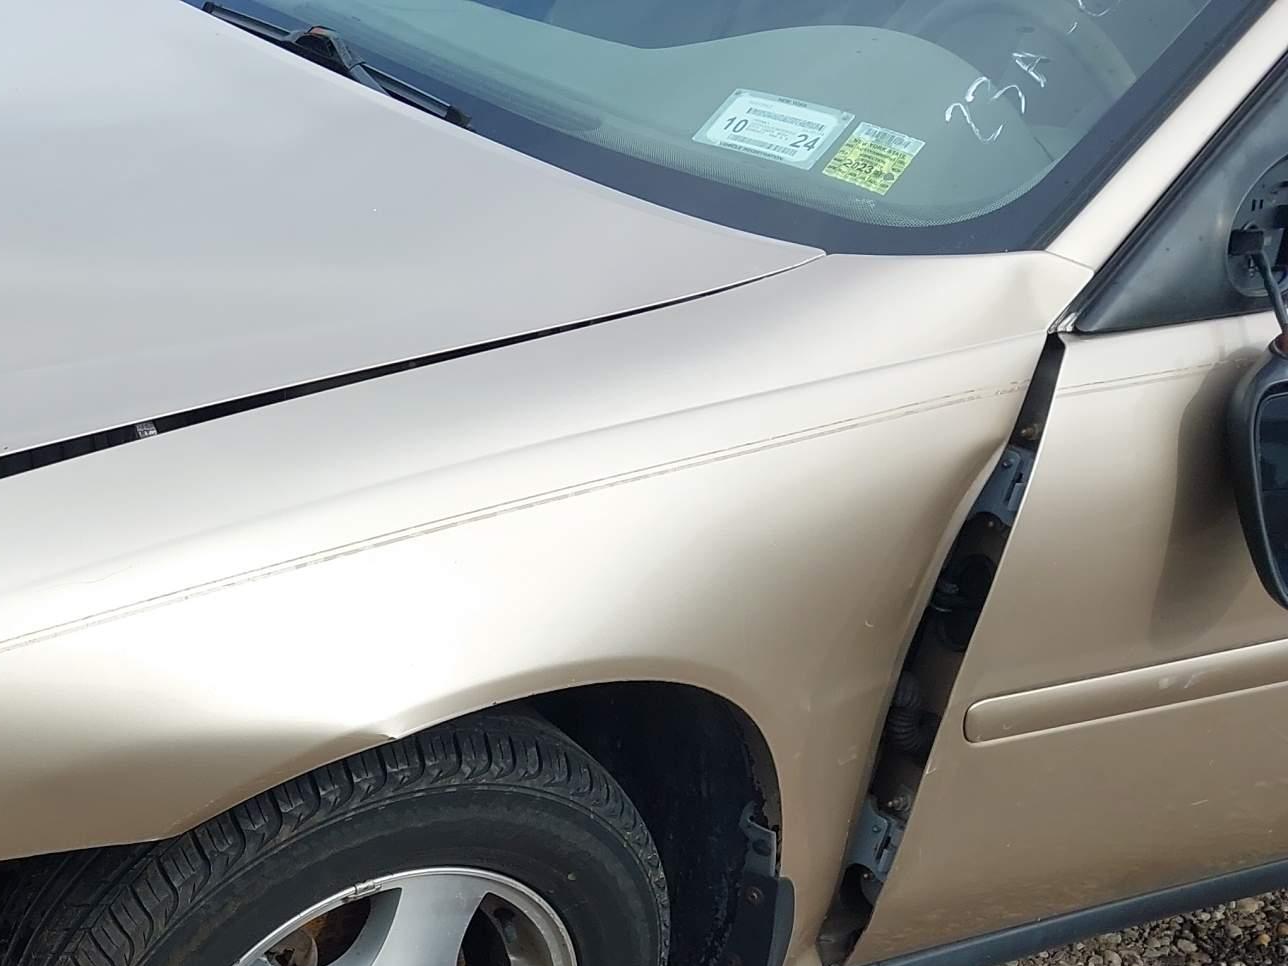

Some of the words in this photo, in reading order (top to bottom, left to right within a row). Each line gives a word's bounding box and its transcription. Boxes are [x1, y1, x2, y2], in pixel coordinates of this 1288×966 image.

[723, 116, 748, 133] 10
[790, 134, 820, 151] 24
[842, 158, 874, 174] 2023
